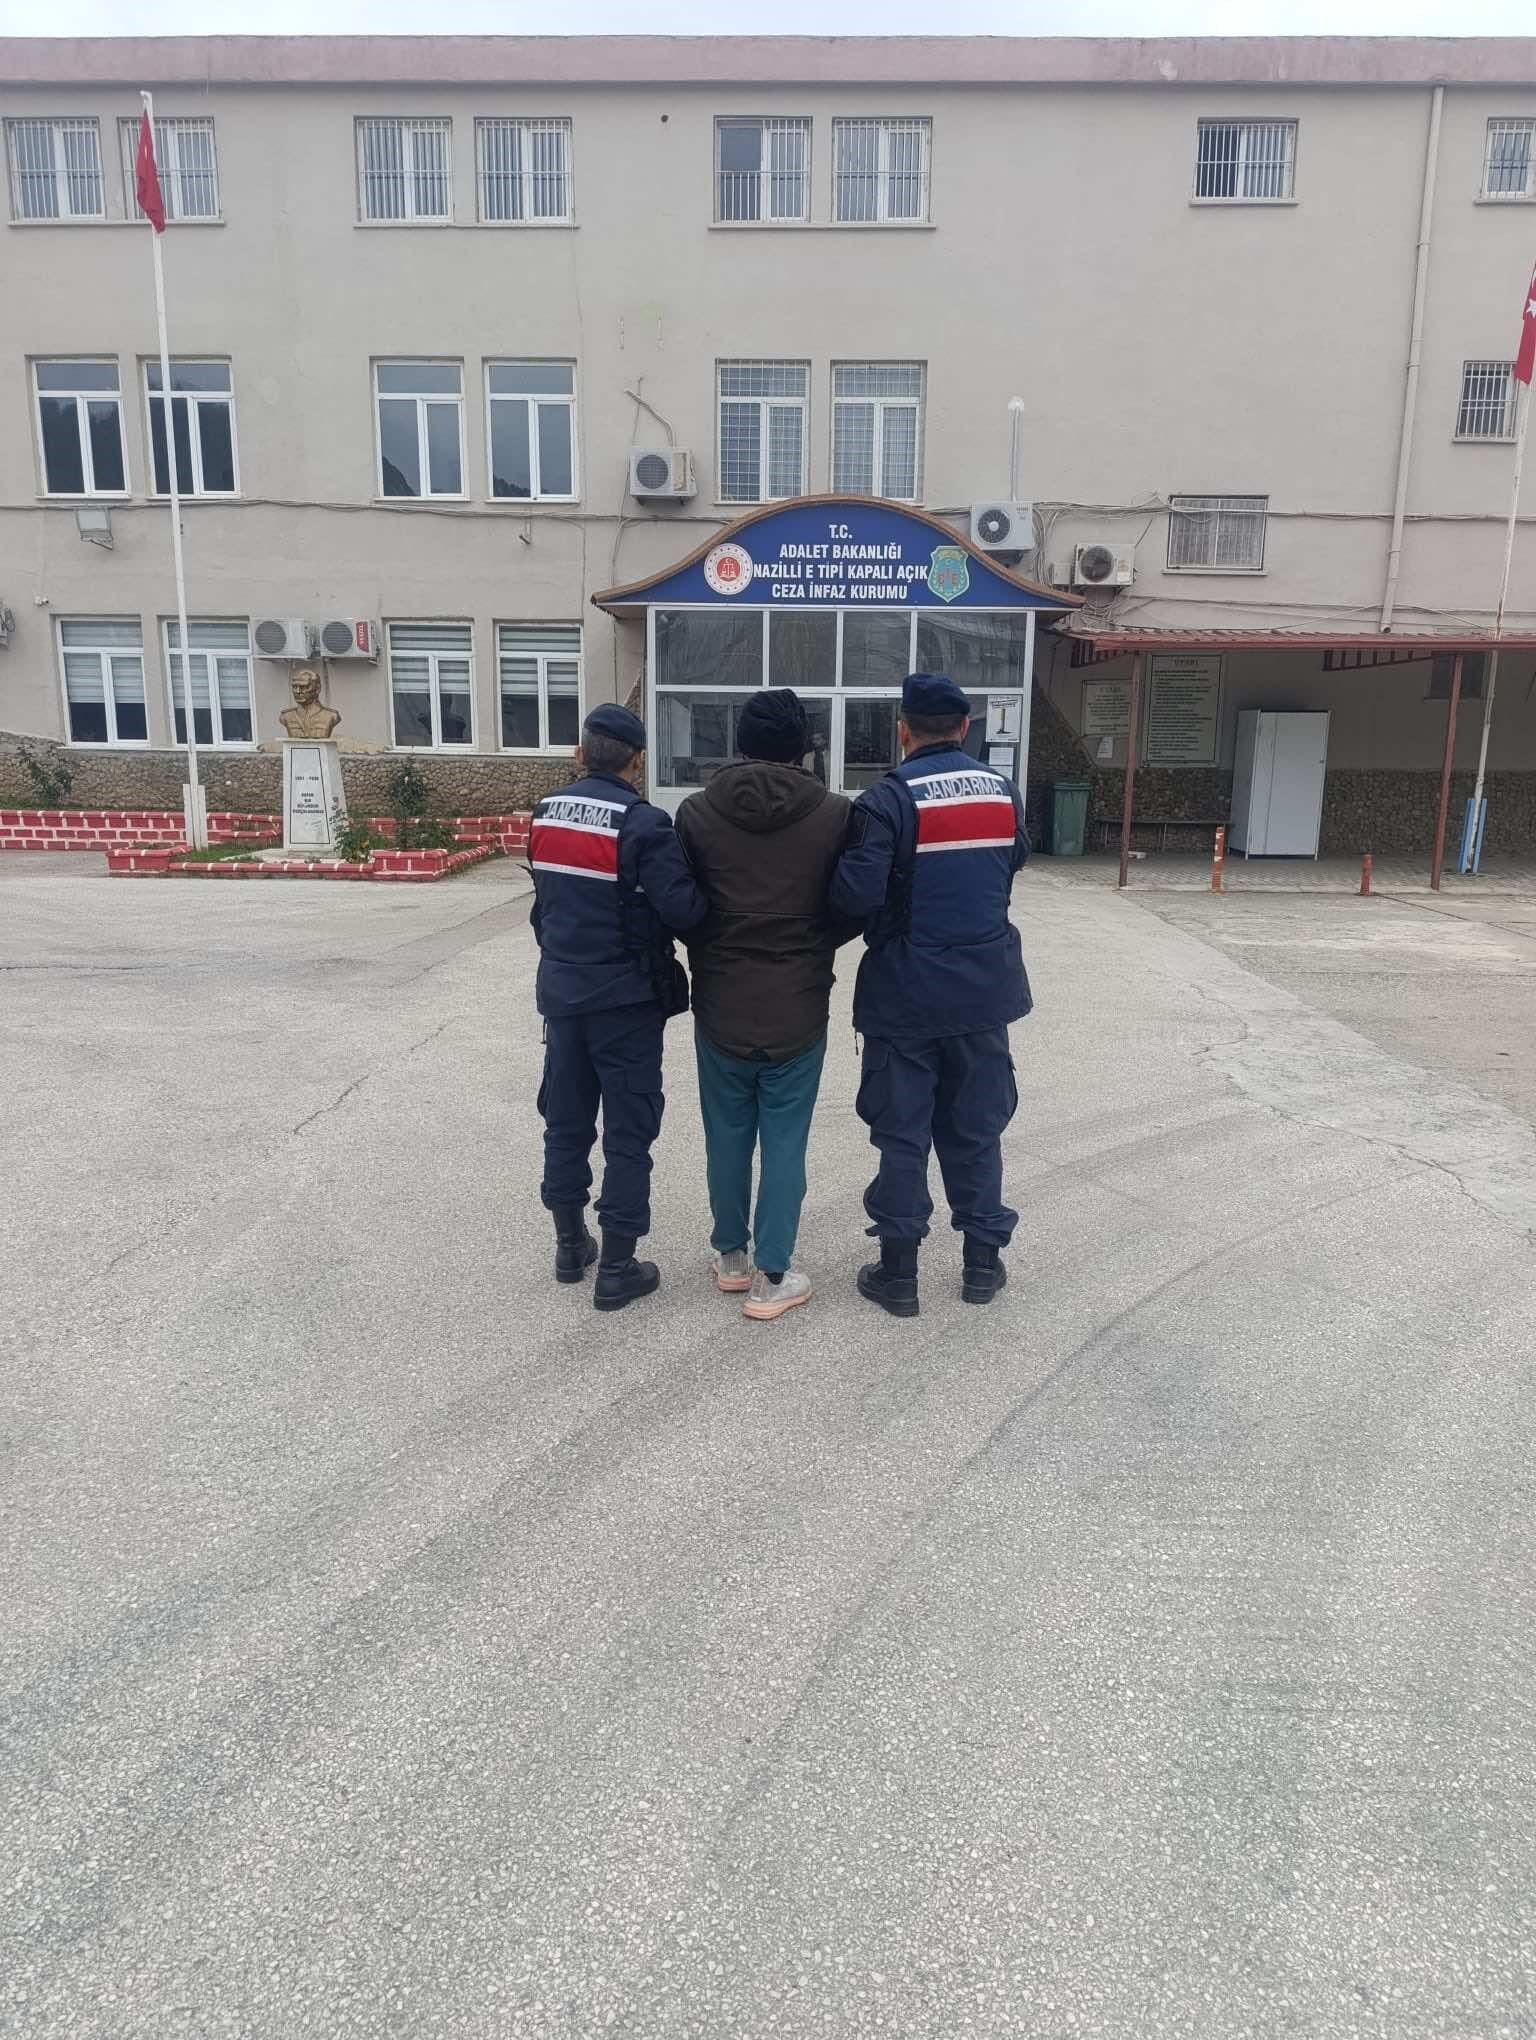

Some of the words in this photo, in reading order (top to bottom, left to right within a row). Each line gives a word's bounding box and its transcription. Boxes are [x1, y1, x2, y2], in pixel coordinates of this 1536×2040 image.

[829, 524, 852, 539] T.C.
[779, 544, 828, 559] ADALET
[832, 542, 902, 560] BAKANLIĞI
[753, 561, 802, 579] NAZİLLİ
[805, 564, 814, 579] E
[817, 561, 844, 579] TİPİ
[847, 564, 893, 579] KAPALI
[896, 565, 929, 583] AÇIK
[771, 583, 806, 598] CEZA
[809, 581, 847, 599] İNFAZ
[850, 584, 908, 600] KURUMU
[924, 776, 1004, 800] JANDARMA
[544, 801, 612, 829] JANDARMA
